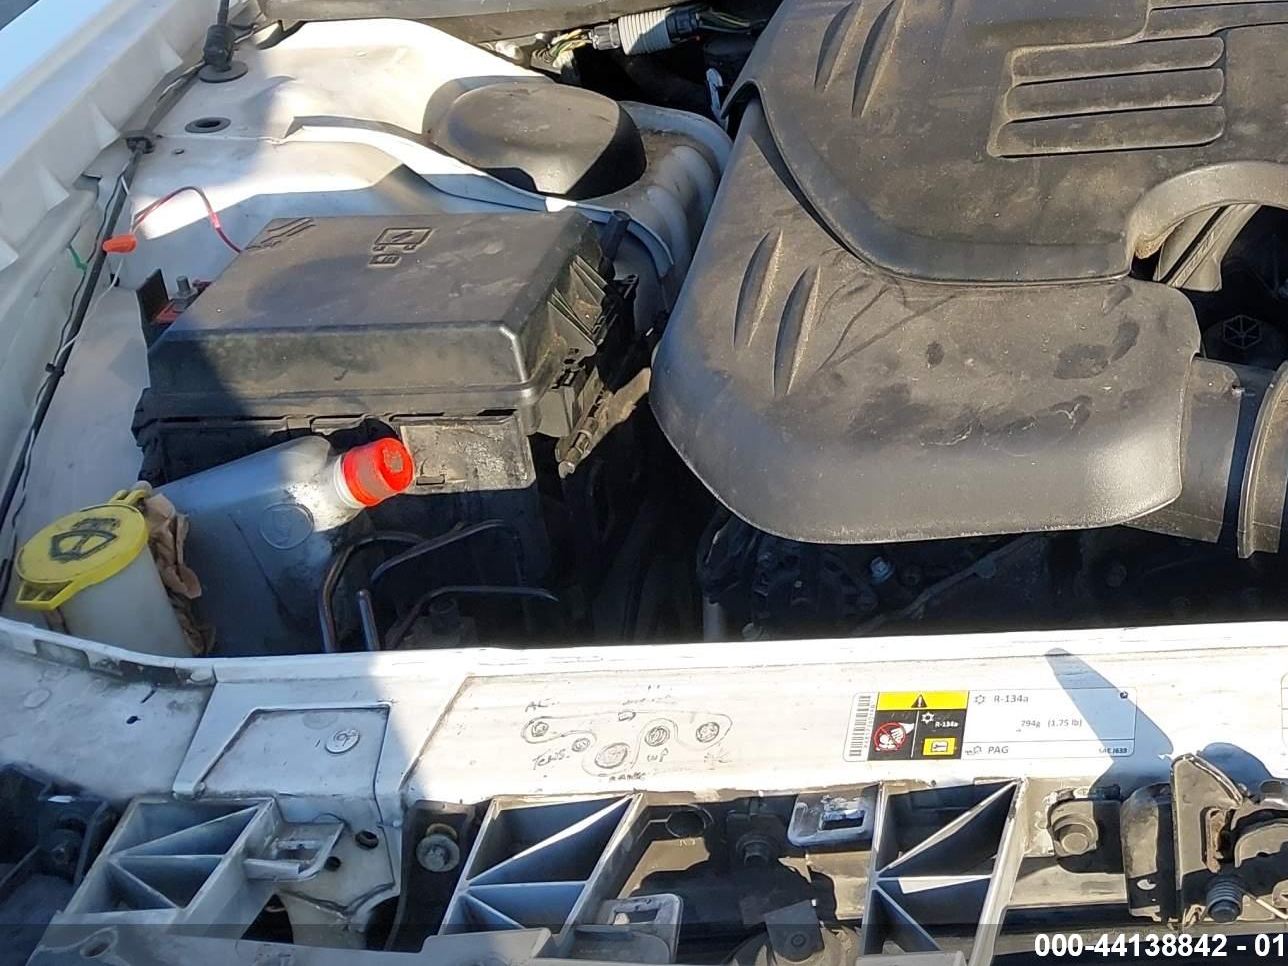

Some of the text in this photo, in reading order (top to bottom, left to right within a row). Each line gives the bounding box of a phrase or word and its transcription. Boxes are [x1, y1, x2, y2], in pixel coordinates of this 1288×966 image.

[993, 695, 1029, 703] R-134a
[1020, 718, 1083, 728] 794g (1.75 lb)
[987, 745, 1009, 754] PAG
